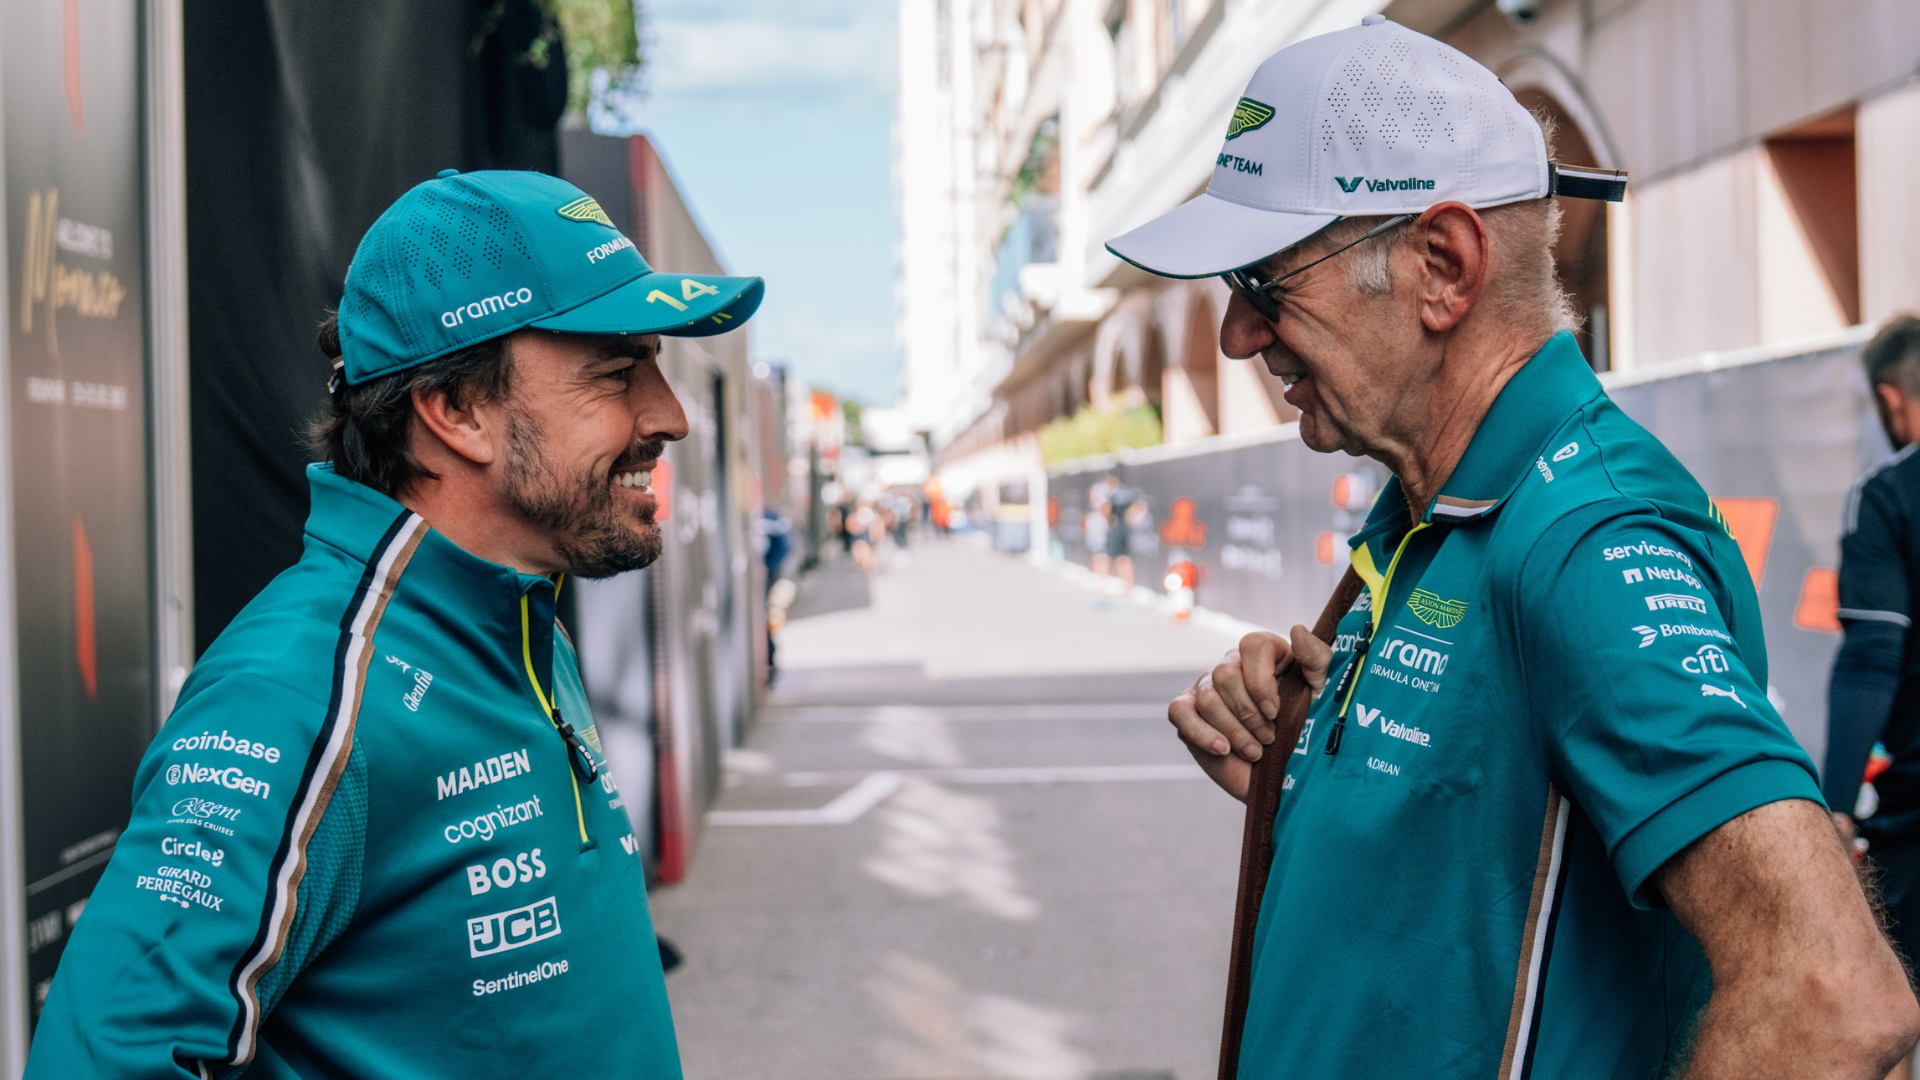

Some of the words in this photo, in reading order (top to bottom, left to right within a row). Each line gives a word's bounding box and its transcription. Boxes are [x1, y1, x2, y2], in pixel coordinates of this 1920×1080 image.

[1234, 156, 1263, 176] TEAM
[1365, 177, 1435, 193] Valvoline
[441, 287, 532, 328] aramco
[646, 279, 720, 312] 14
[1645, 566, 1702, 590] NetApp
[1420, 598, 1440, 609] ASTON
[1644, 593, 1707, 614] PIRELLI
[1682, 645, 1730, 674] citi
[172, 730, 280, 763] coinbase
[182, 763, 270, 799] NexGen
[436, 748, 531, 801] MAADEN
[1366, 756, 1400, 776] ADRIAN
[171, 797, 242, 821] Regent
[444, 794, 543, 843] cognizant
[185, 818, 203, 826] SEAS
[203, 821, 234, 836] CRUISES
[157, 866, 212, 889] GIRARD
[466, 848, 546, 896] BOSS
[136, 876, 224, 912] PERREGAUX
[473, 902, 558, 953] JCB
[472, 959, 569, 996] SentinelOne
